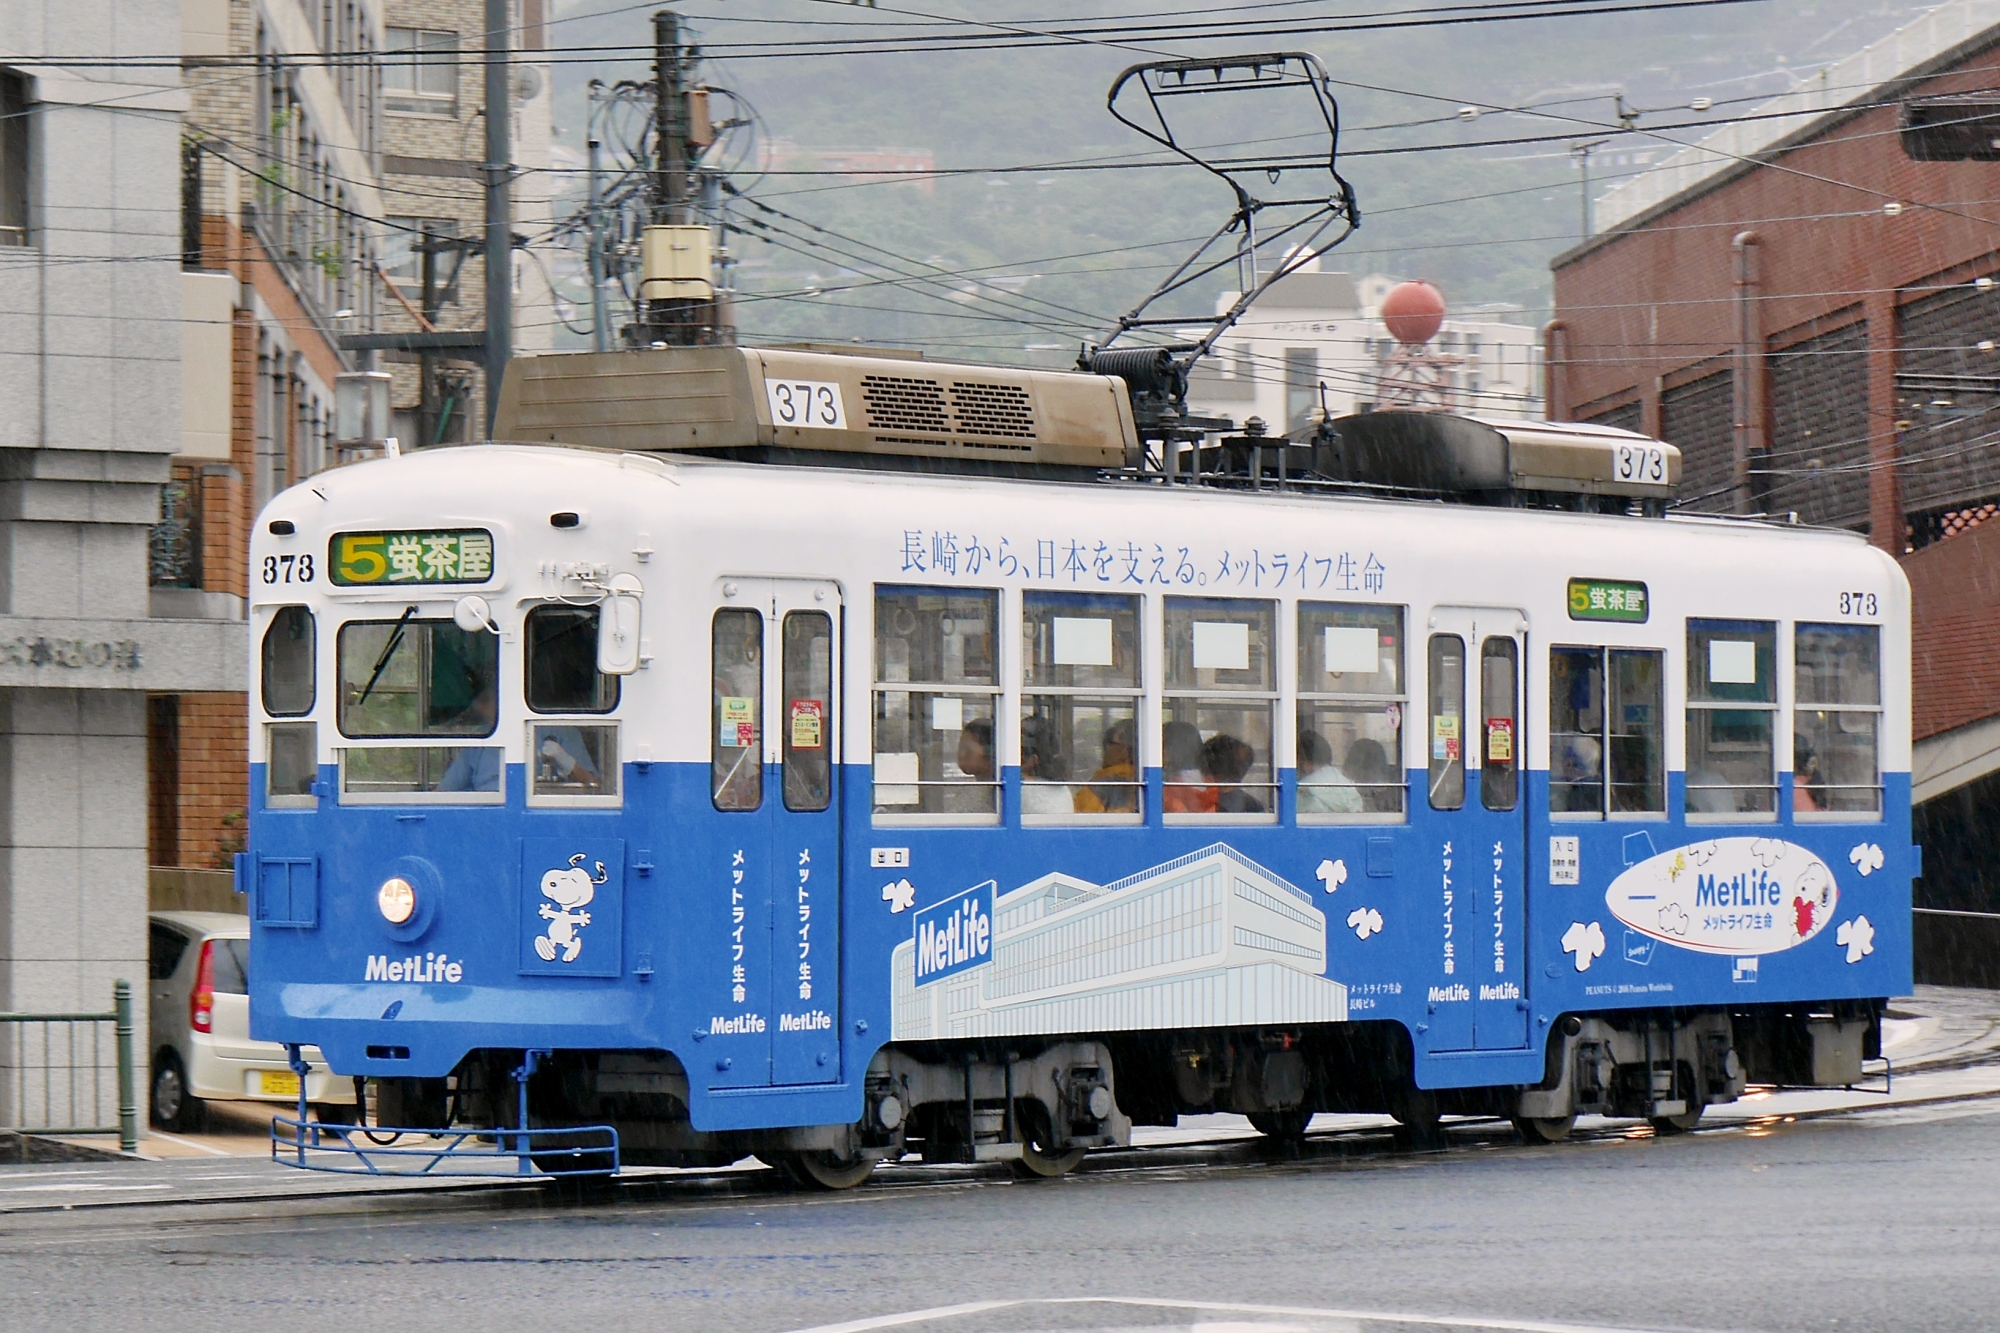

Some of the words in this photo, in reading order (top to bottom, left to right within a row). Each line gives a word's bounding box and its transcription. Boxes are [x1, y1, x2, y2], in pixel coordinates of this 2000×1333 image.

[776, 383, 837, 425] 373
[1620, 446, 1662, 481] 373
[263, 554, 315, 585] 373
[340, 535, 386, 583] 5
[388, 534, 491, 581] 蛍茶屋
[1569, 583, 1590, 611] 5
[1590, 587, 1644, 611] 蛍茶屋
[1839, 592, 1878, 616] 373
[1696, 866, 1782, 907] MetLife
[1443, 840, 1455, 975] メットライフ生命
[1494, 840, 1505, 974] メットライフ生命
[1703, 913, 1773, 930] メットライフ生命
[731, 849, 746, 1003] メットライフ生命
[797, 848, 812, 1001] メットライフ生命
[917, 898, 990, 977] MetLife
[364, 952, 463, 983] MetLife
[1428, 983, 1471, 1002] MetLife
[1479, 981, 1520, 1001] MetLife
[710, 1012, 766, 1035] MetLife
[779, 1009, 832, 1032] MetLife
